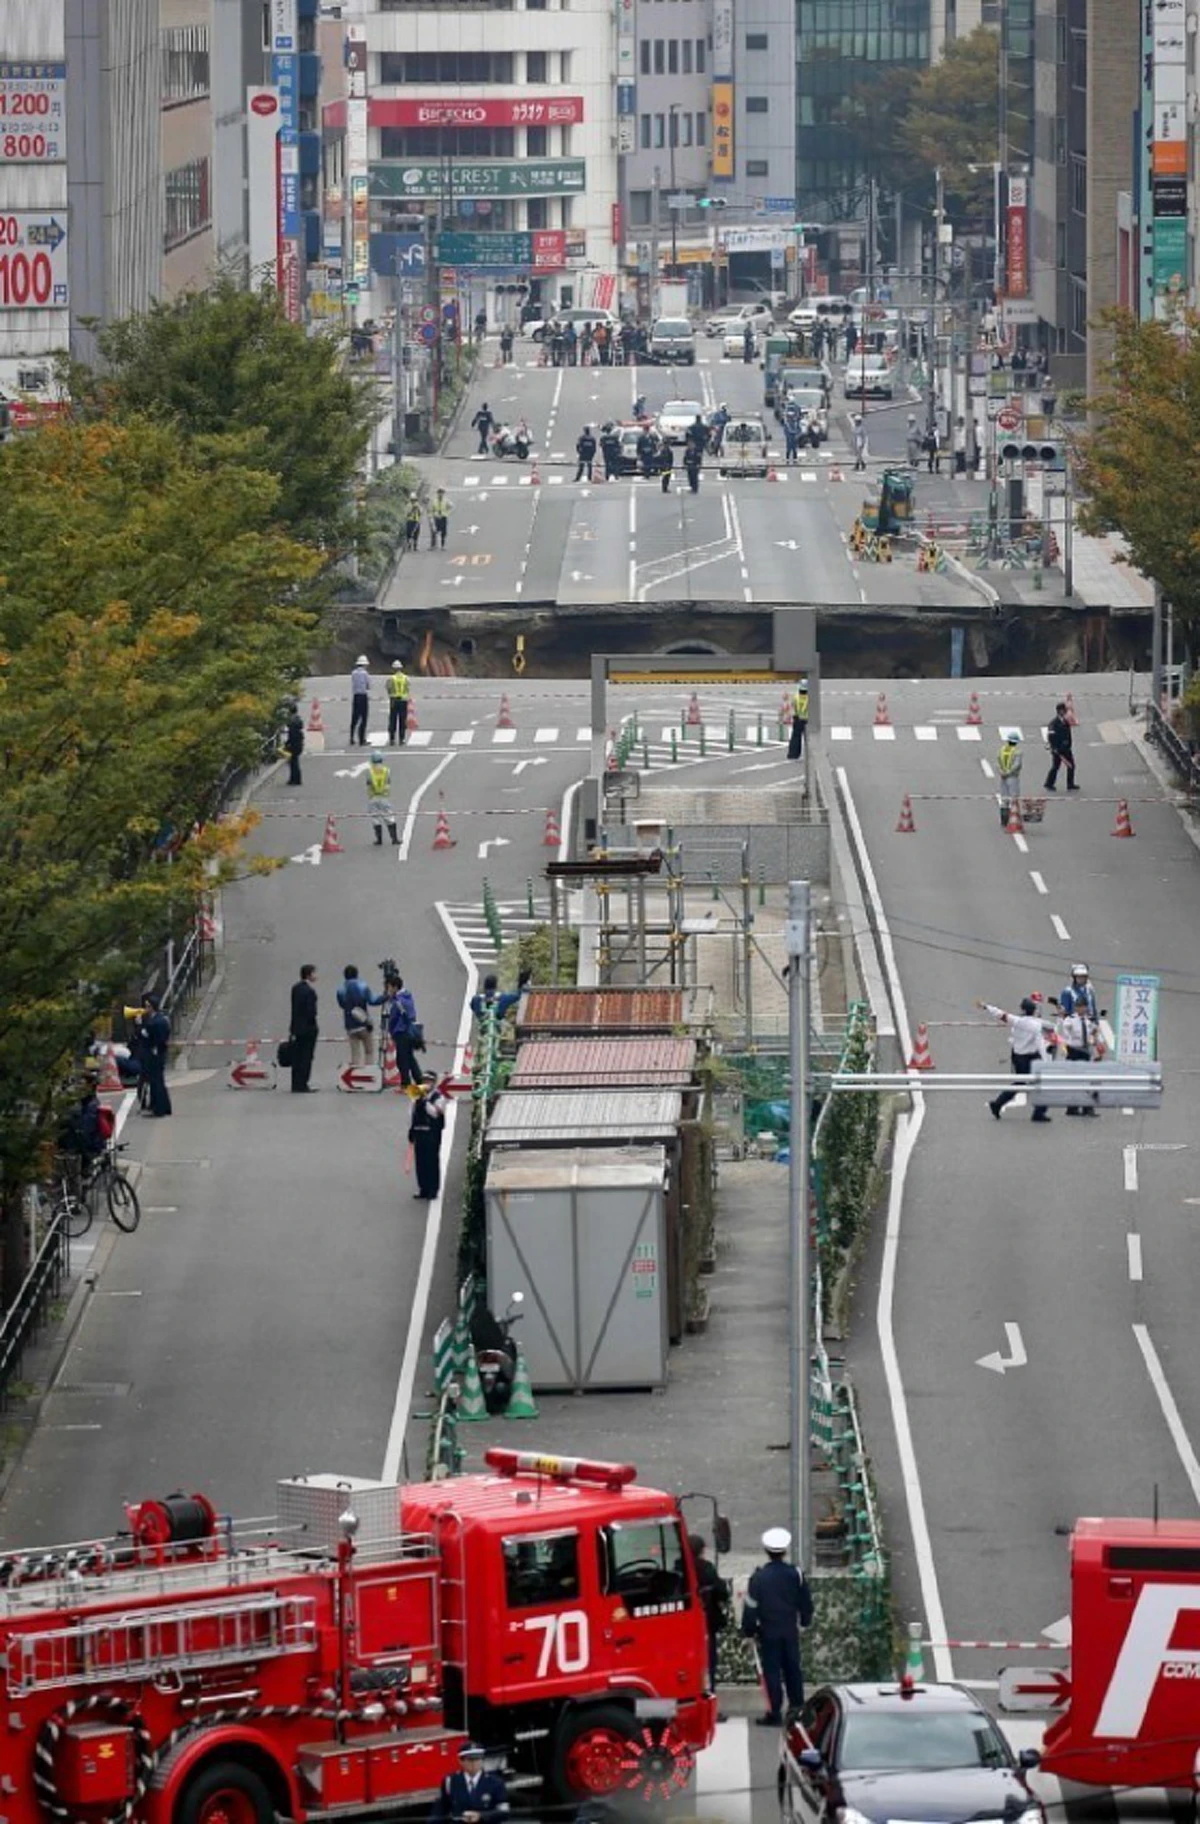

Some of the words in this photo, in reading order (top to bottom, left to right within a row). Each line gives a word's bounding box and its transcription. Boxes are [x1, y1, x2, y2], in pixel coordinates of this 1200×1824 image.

[449, 554, 492, 566] 40
[1132, 989, 1150, 1054] 立入禁止
[524, 1609, 589, 1678] 70
